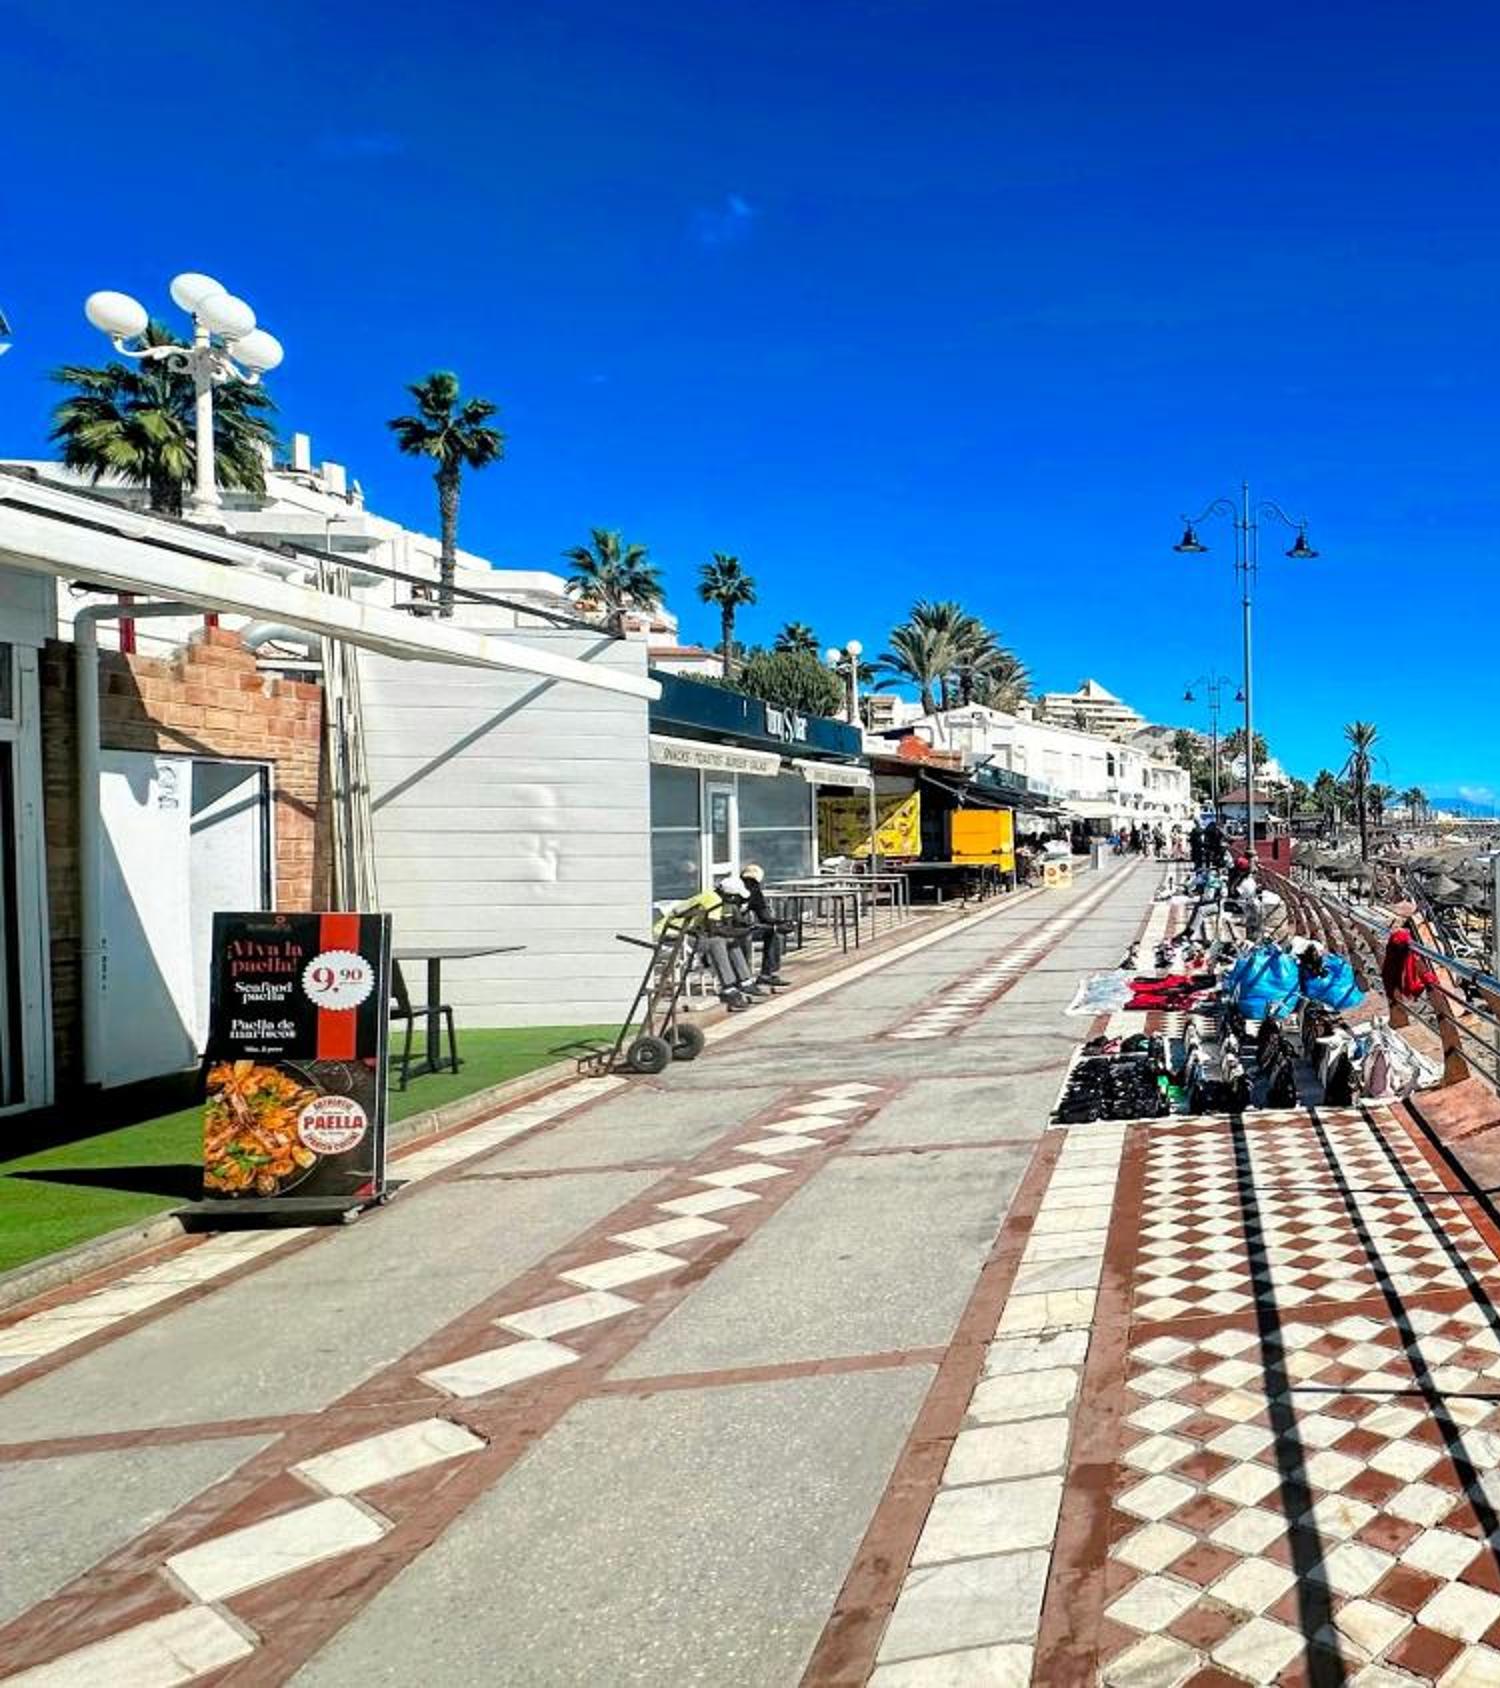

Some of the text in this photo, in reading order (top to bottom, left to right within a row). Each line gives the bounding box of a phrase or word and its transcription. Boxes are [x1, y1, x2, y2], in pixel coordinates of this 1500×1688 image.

[285, 940, 303, 957] la
[231, 957, 297, 977] paella!
[235, 981, 293, 993] Seafood
[243, 988, 285, 1005] paella
[232, 1018, 295, 1031] Paella de
[229, 1029, 297, 1039] mariscos
[303, 1115, 363, 1130] PAELLA
